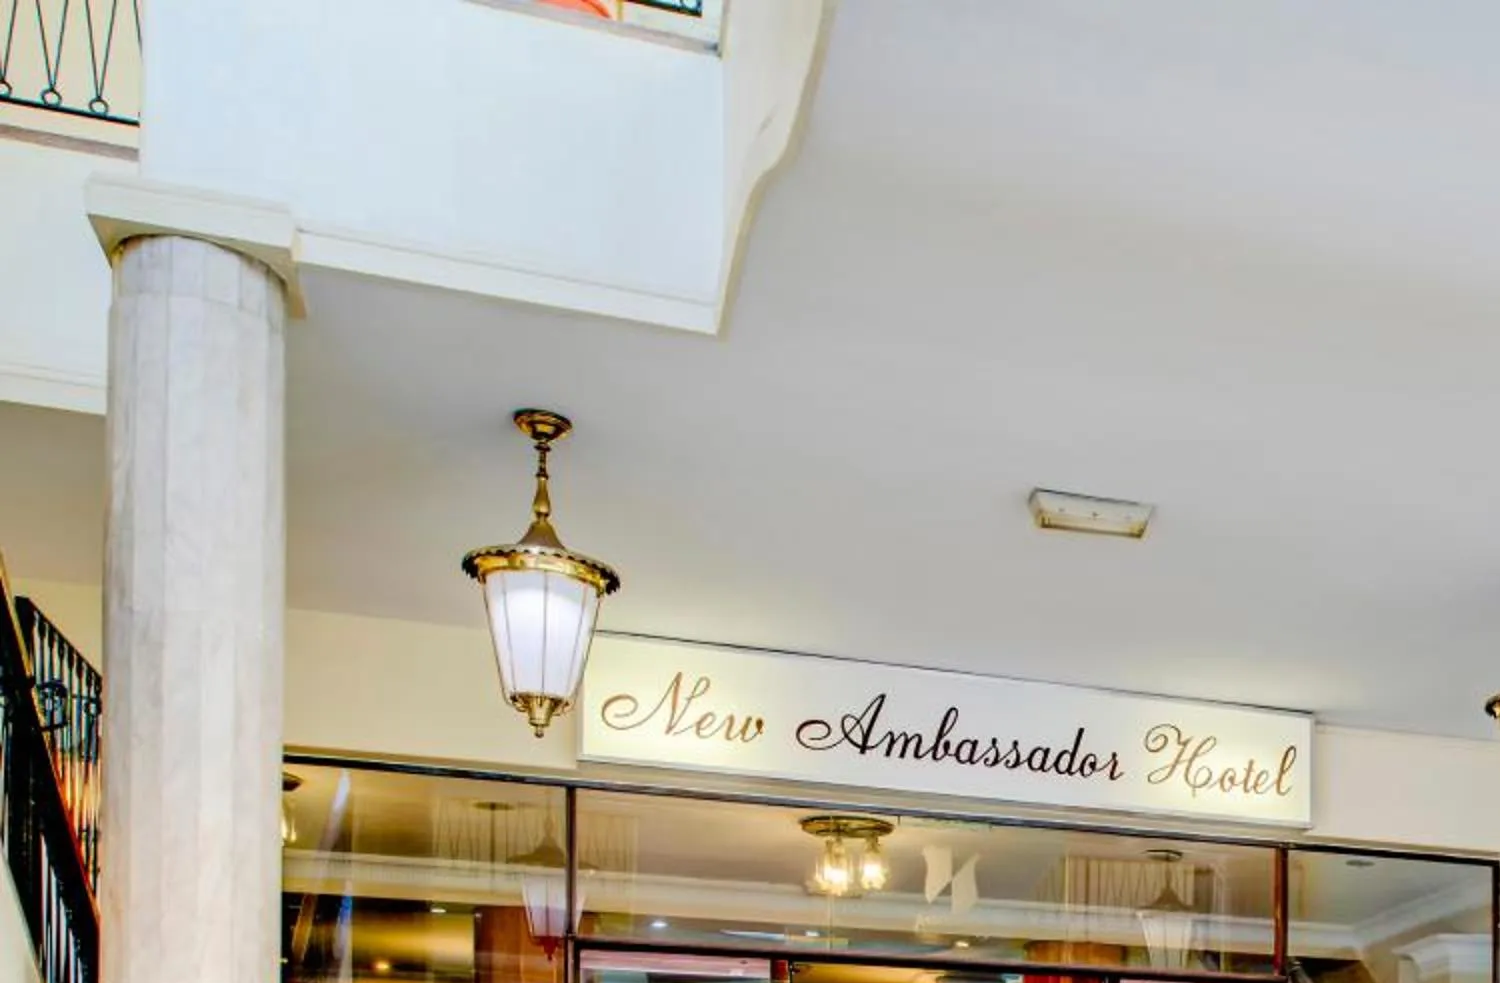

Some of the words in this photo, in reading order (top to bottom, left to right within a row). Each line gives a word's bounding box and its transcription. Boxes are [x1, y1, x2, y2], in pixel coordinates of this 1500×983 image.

[601, 671, 764, 743] New
[796, 694, 1123, 782] Ambassador
[1144, 724, 1298, 798] Hotel
